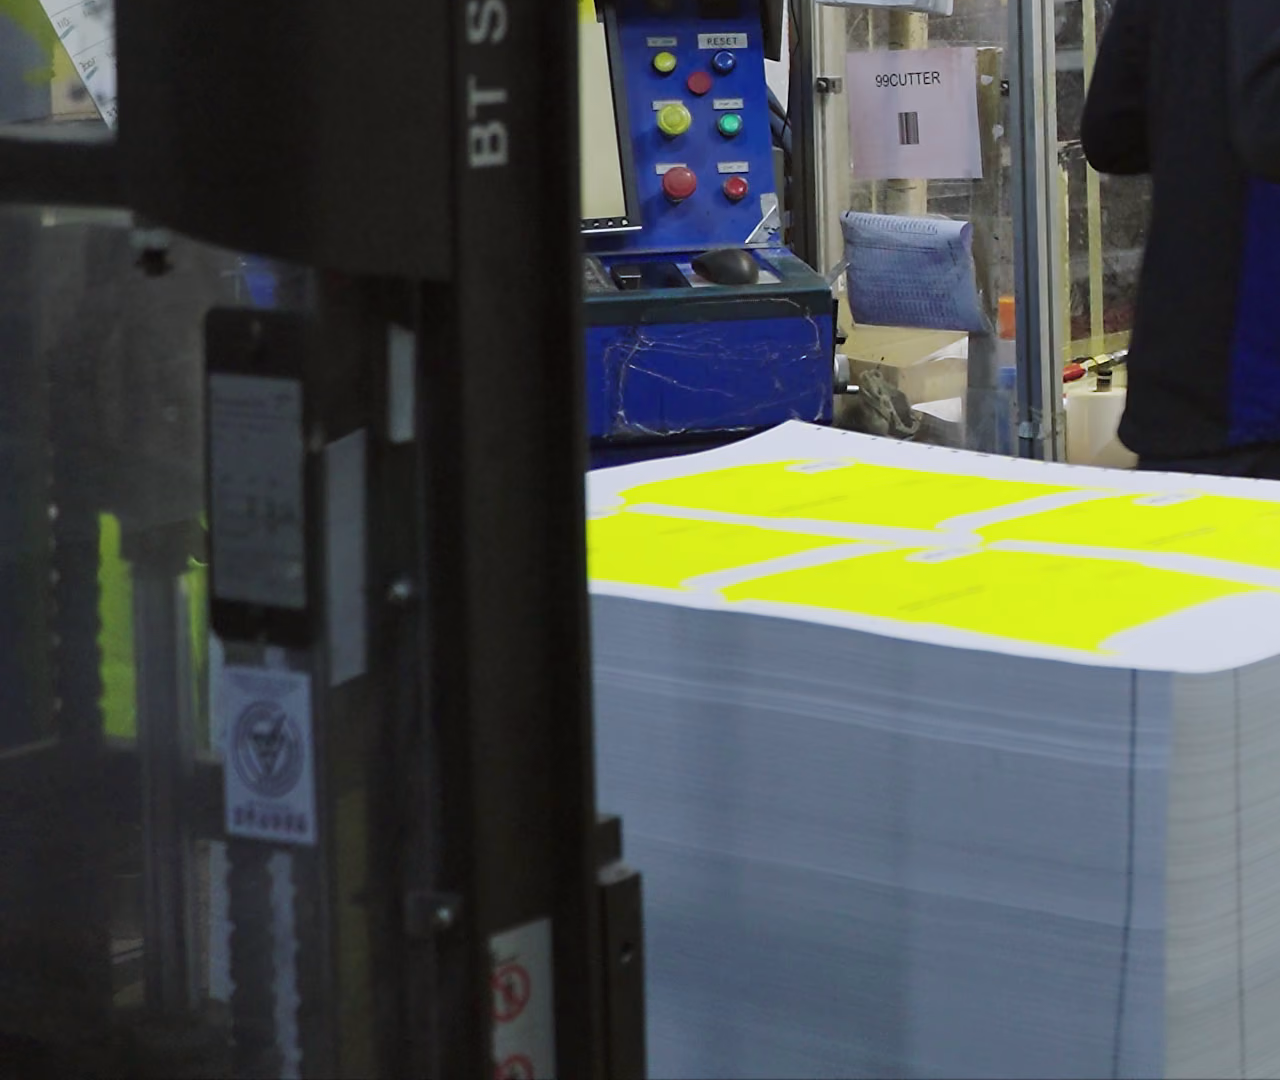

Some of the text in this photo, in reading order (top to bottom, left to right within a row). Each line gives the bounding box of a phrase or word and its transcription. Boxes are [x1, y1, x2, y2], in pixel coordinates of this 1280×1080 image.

[706, 36, 739, 47] RESET
[875, 71, 941, 88] 99CUTTER
[468, 75, 508, 169] BT
